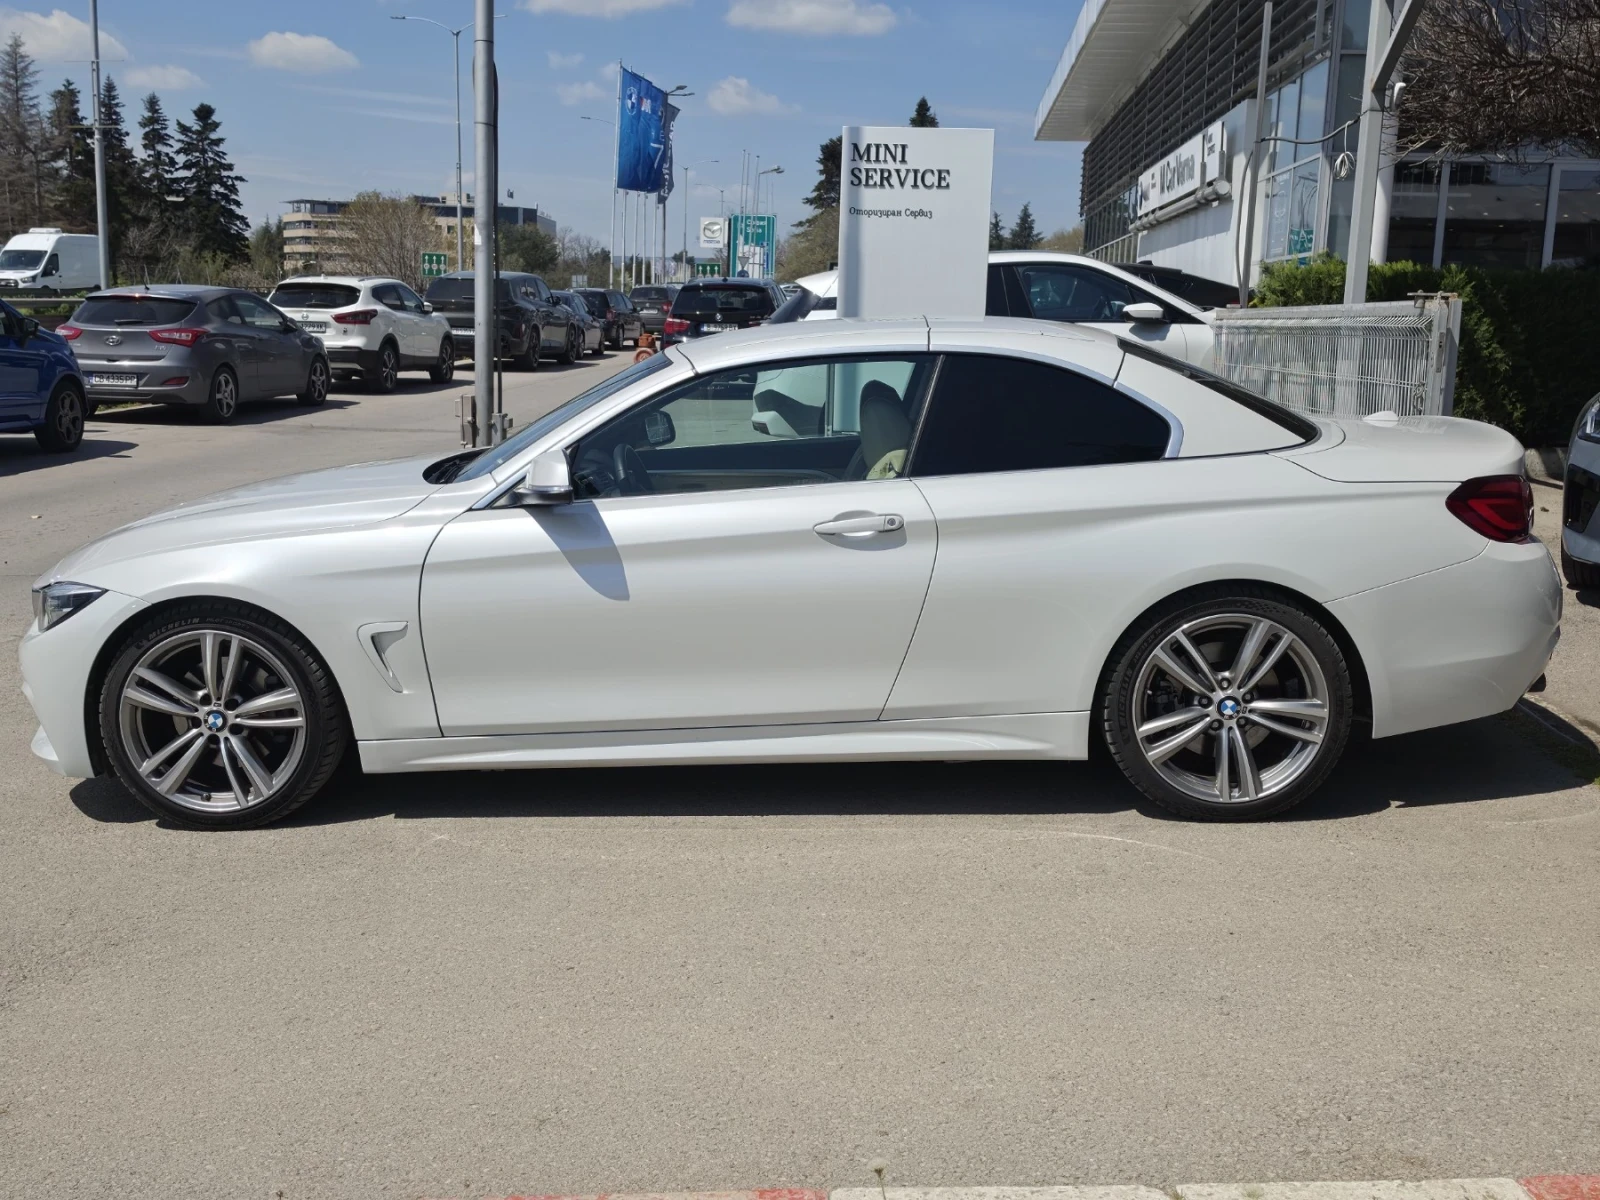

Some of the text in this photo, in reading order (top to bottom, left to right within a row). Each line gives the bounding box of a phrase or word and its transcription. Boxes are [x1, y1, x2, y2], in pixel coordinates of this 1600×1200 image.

[850, 142, 909, 164] MINI
[850, 166, 951, 190] SERVICE
[1166, 160, 1176, 193] Car
[1176, 153, 1195, 187] Varna
[849, 206, 933, 220] Оторизиран Сервиз
[148, 617, 200, 640] MICHELIN
